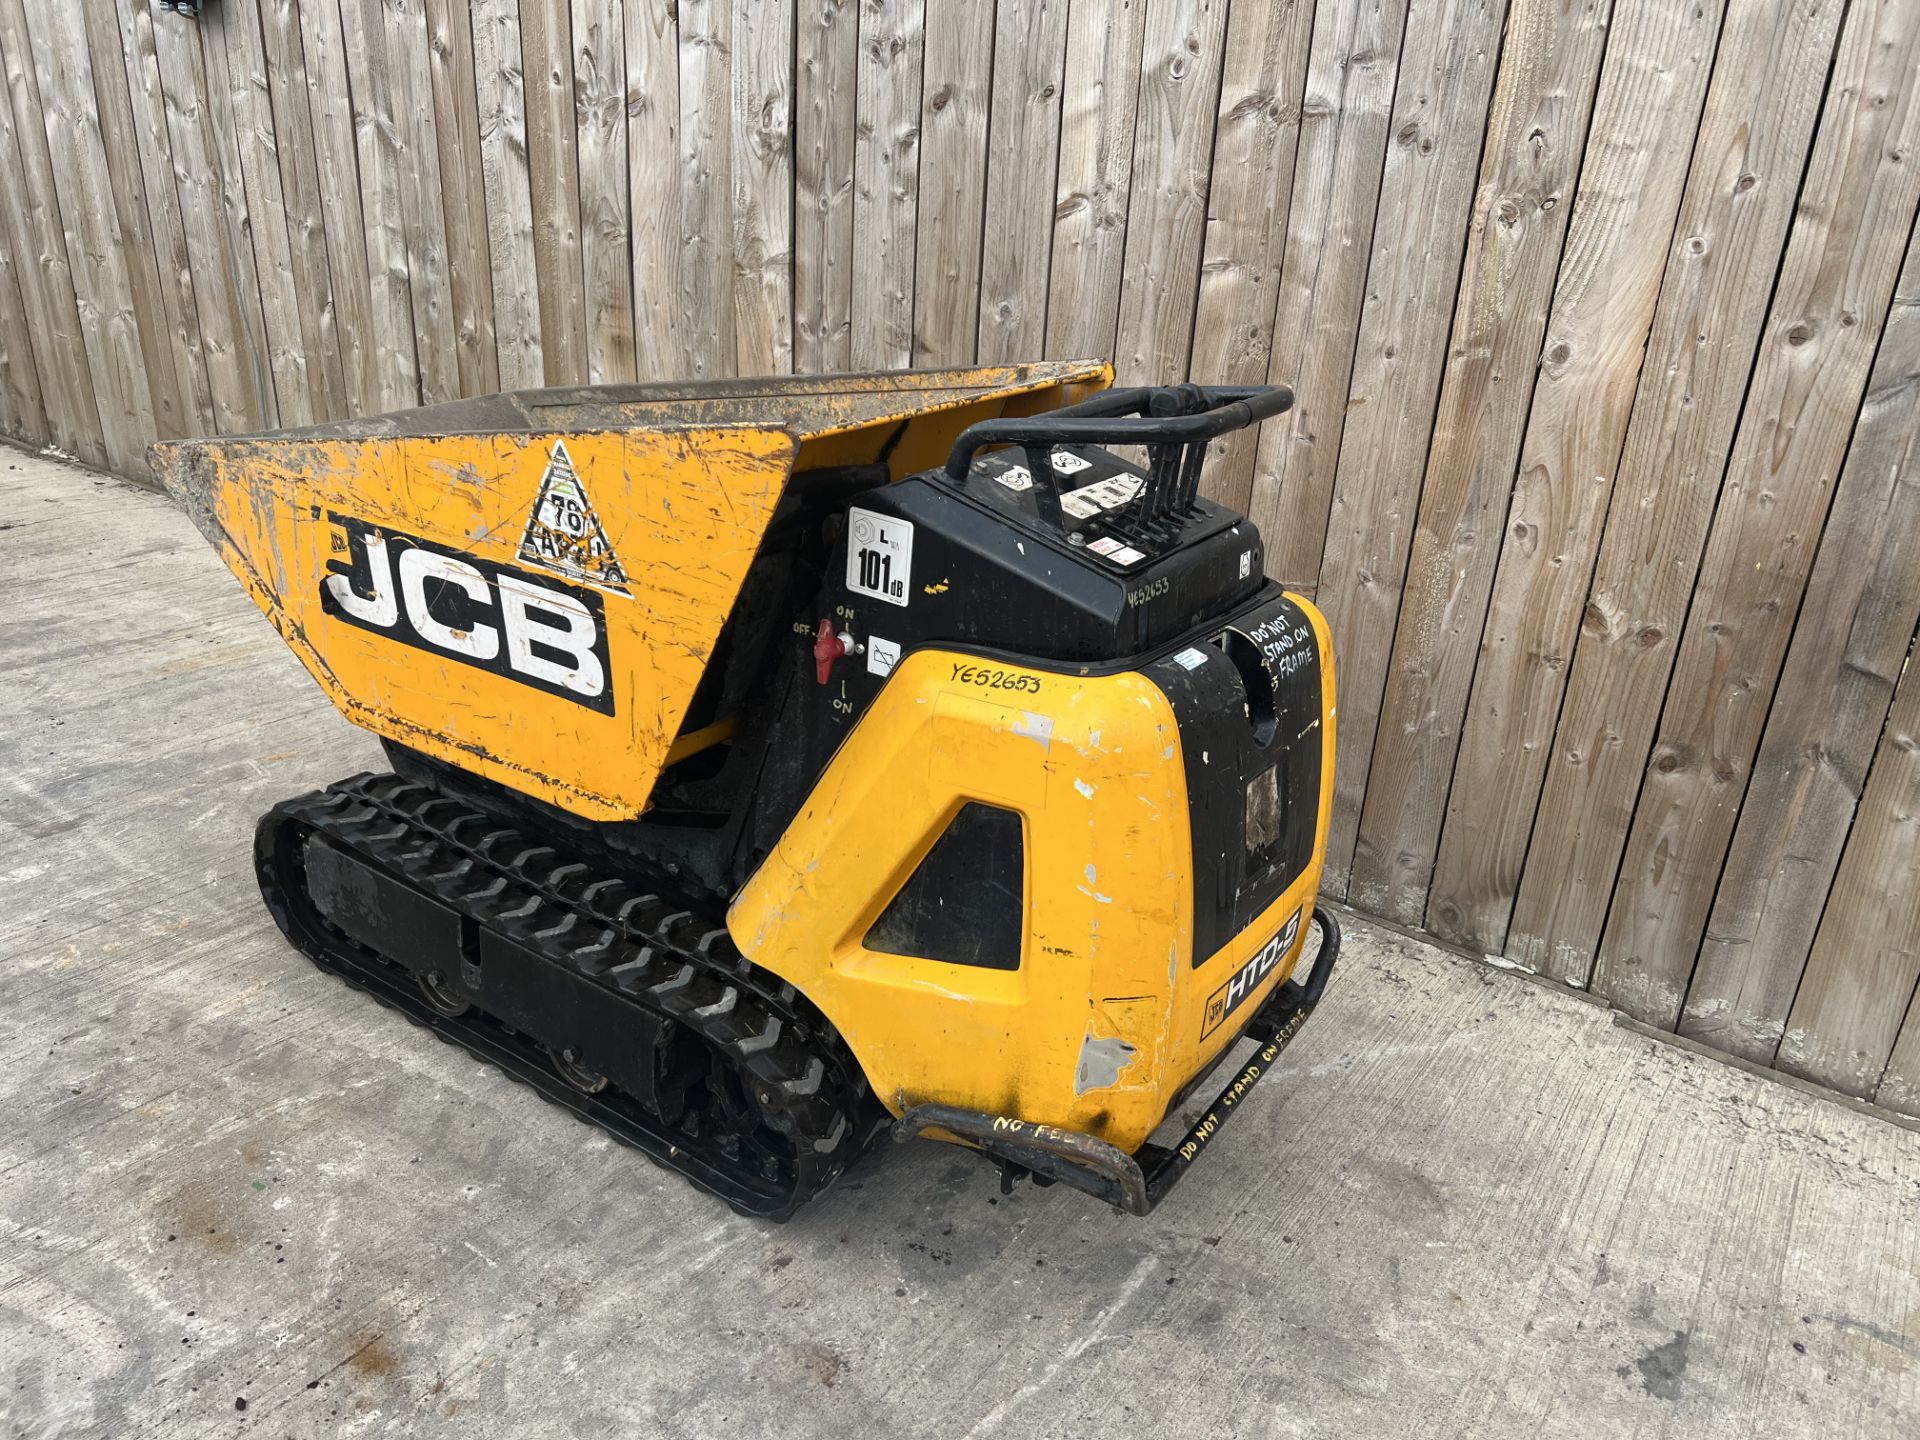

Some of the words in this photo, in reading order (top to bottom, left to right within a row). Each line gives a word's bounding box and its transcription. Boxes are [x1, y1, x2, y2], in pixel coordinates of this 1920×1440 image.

[880, 529, 889, 544] L
[858, 548, 891, 596] 101
[890, 580, 904, 598] dB
[328, 533, 605, 697] JCB
[836, 605, 855, 620] ON
[793, 622, 811, 636] OFF
[1250, 629, 1267, 643] DO
[1267, 614, 1291, 637] NOT
[1263, 635, 1294, 663] STAND
[1293, 625, 1309, 643] ON
[1278, 645, 1313, 679] FRAME
[950, 663, 1042, 694] YE52653
[832, 698, 853, 714] ON
[1225, 910, 1300, 1011] HTD-5
[1179, 1141, 1197, 1162] DO
[1195, 1113, 1219, 1142] NOT
[1261, 1044, 1278, 1062] ON
[993, 1116, 1024, 1132] NO
